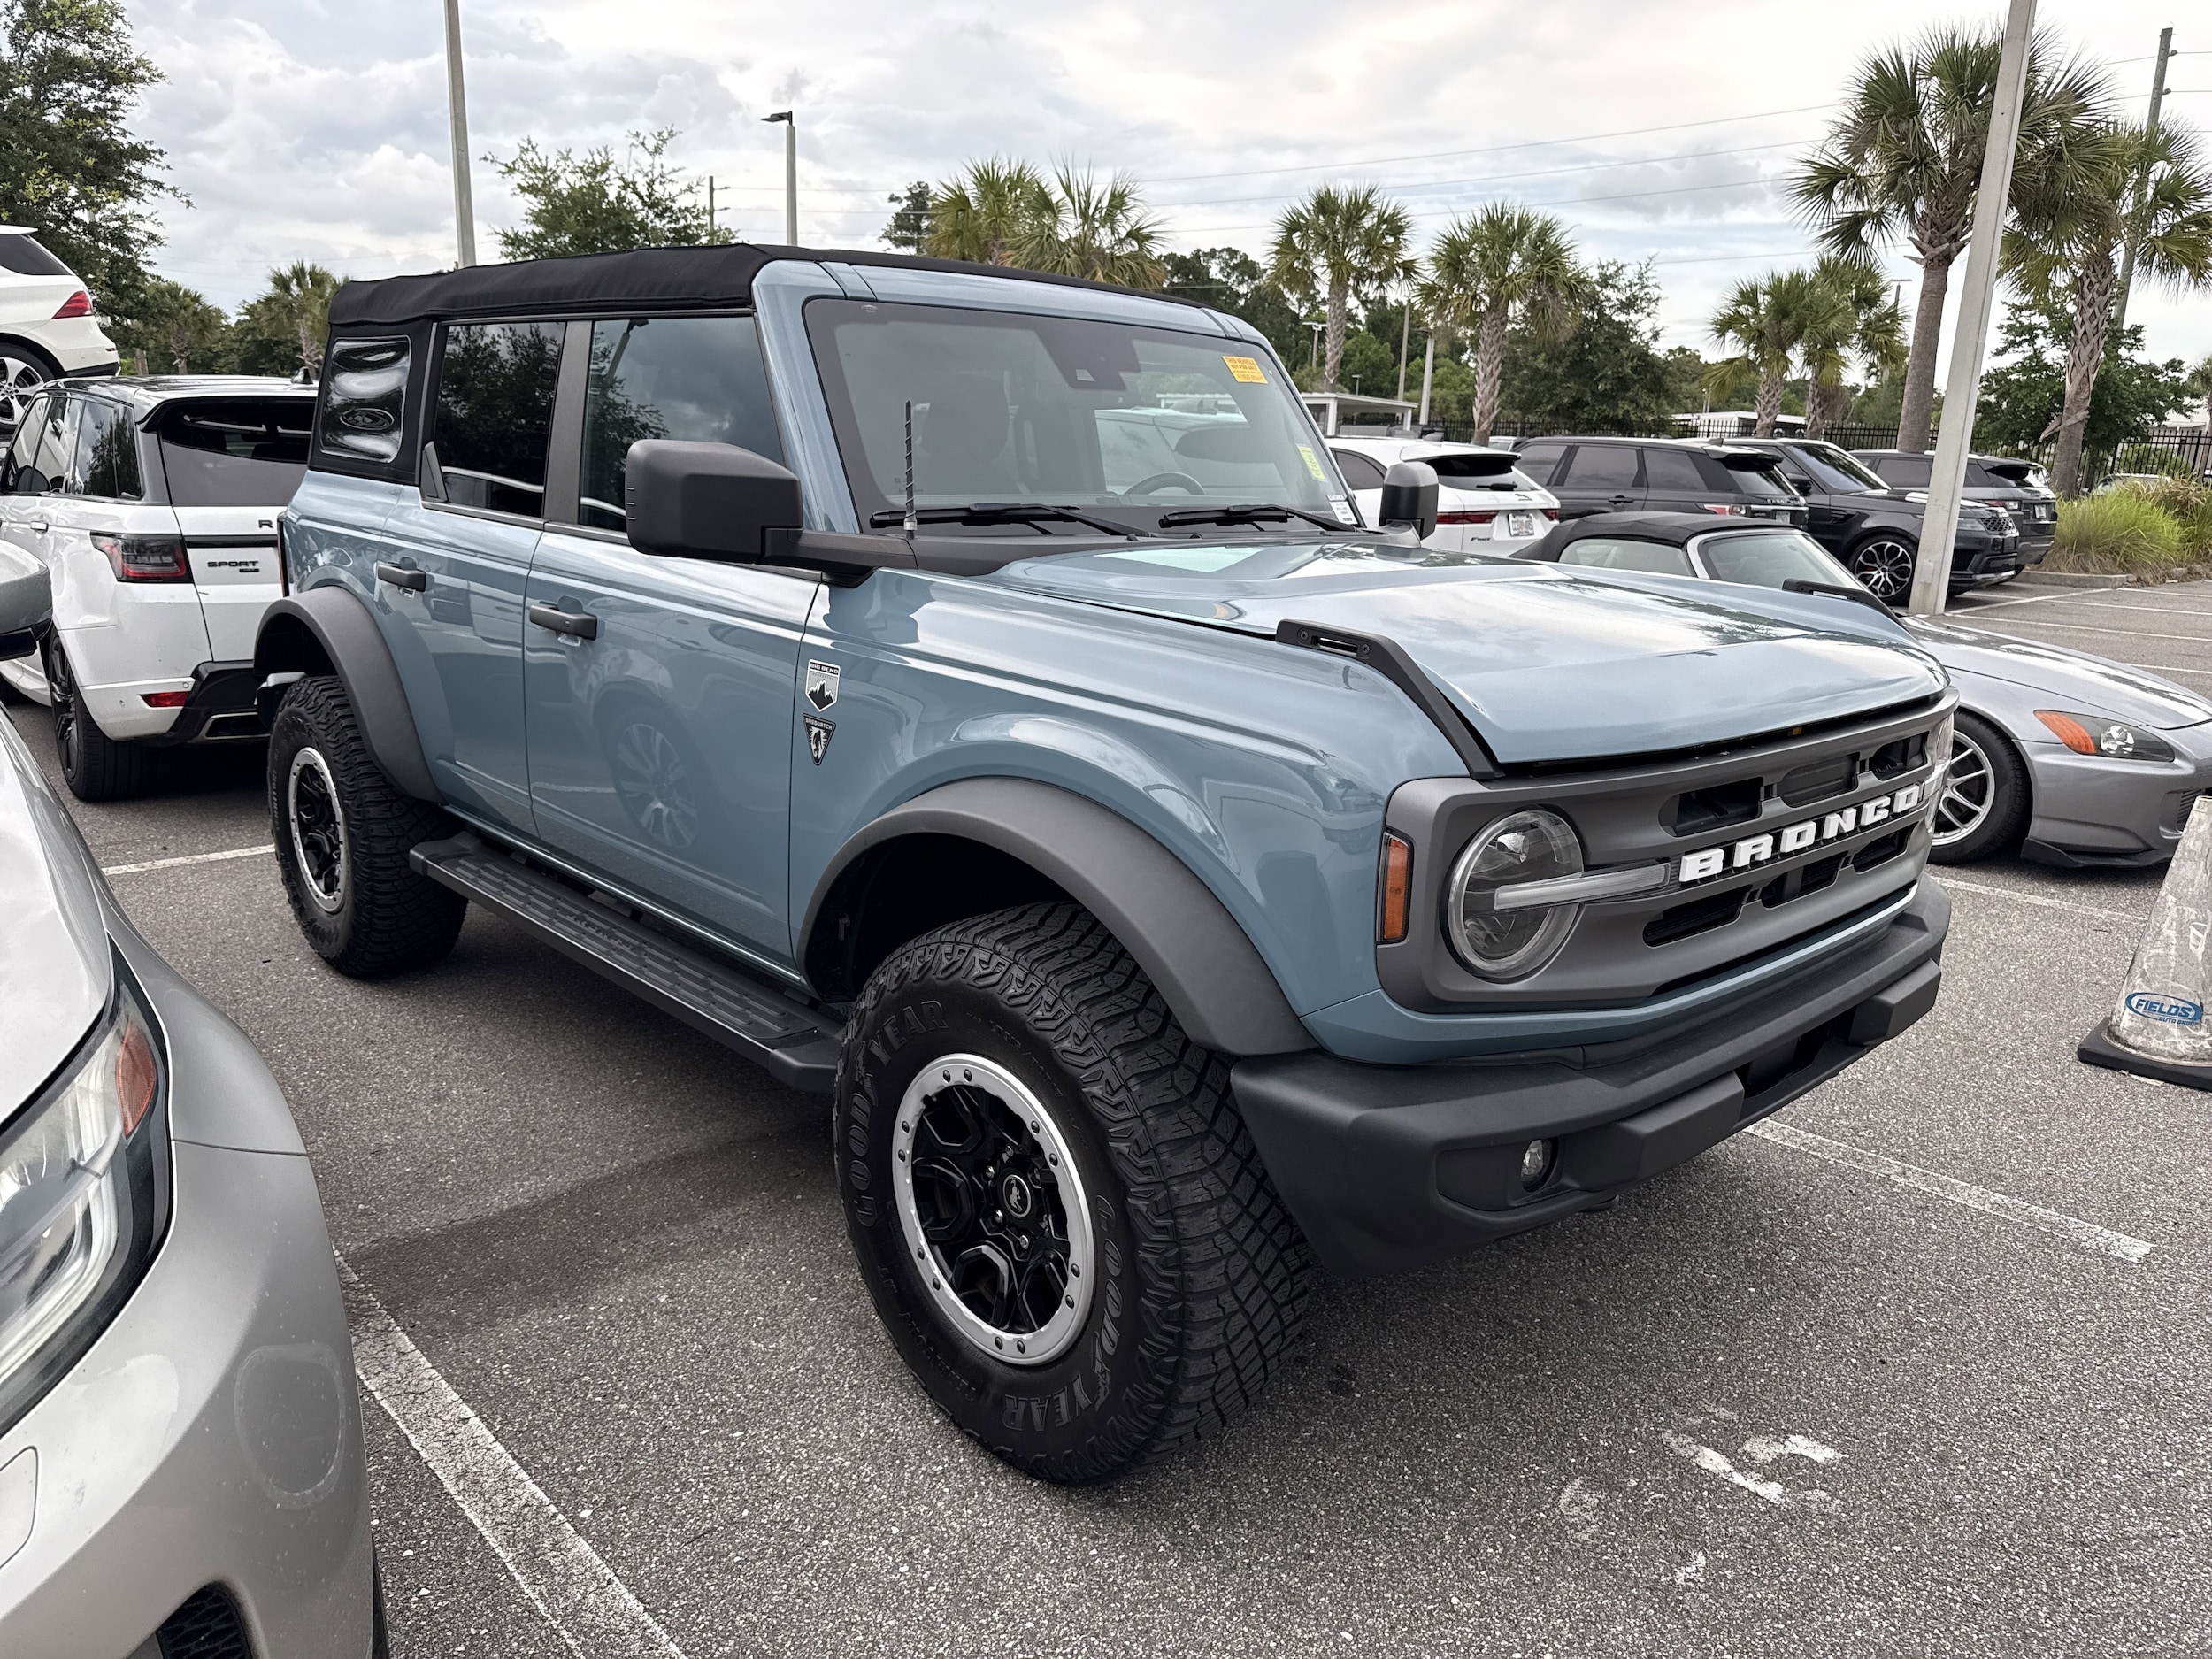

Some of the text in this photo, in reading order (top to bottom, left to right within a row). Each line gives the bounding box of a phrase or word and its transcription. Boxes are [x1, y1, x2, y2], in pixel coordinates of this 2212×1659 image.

[821, 664, 839, 675] BEND
[805, 717, 833, 730] SASQUATCH
[1678, 783, 1920, 882] BRONCO
[2134, 998, 2193, 1018] FIELDS
